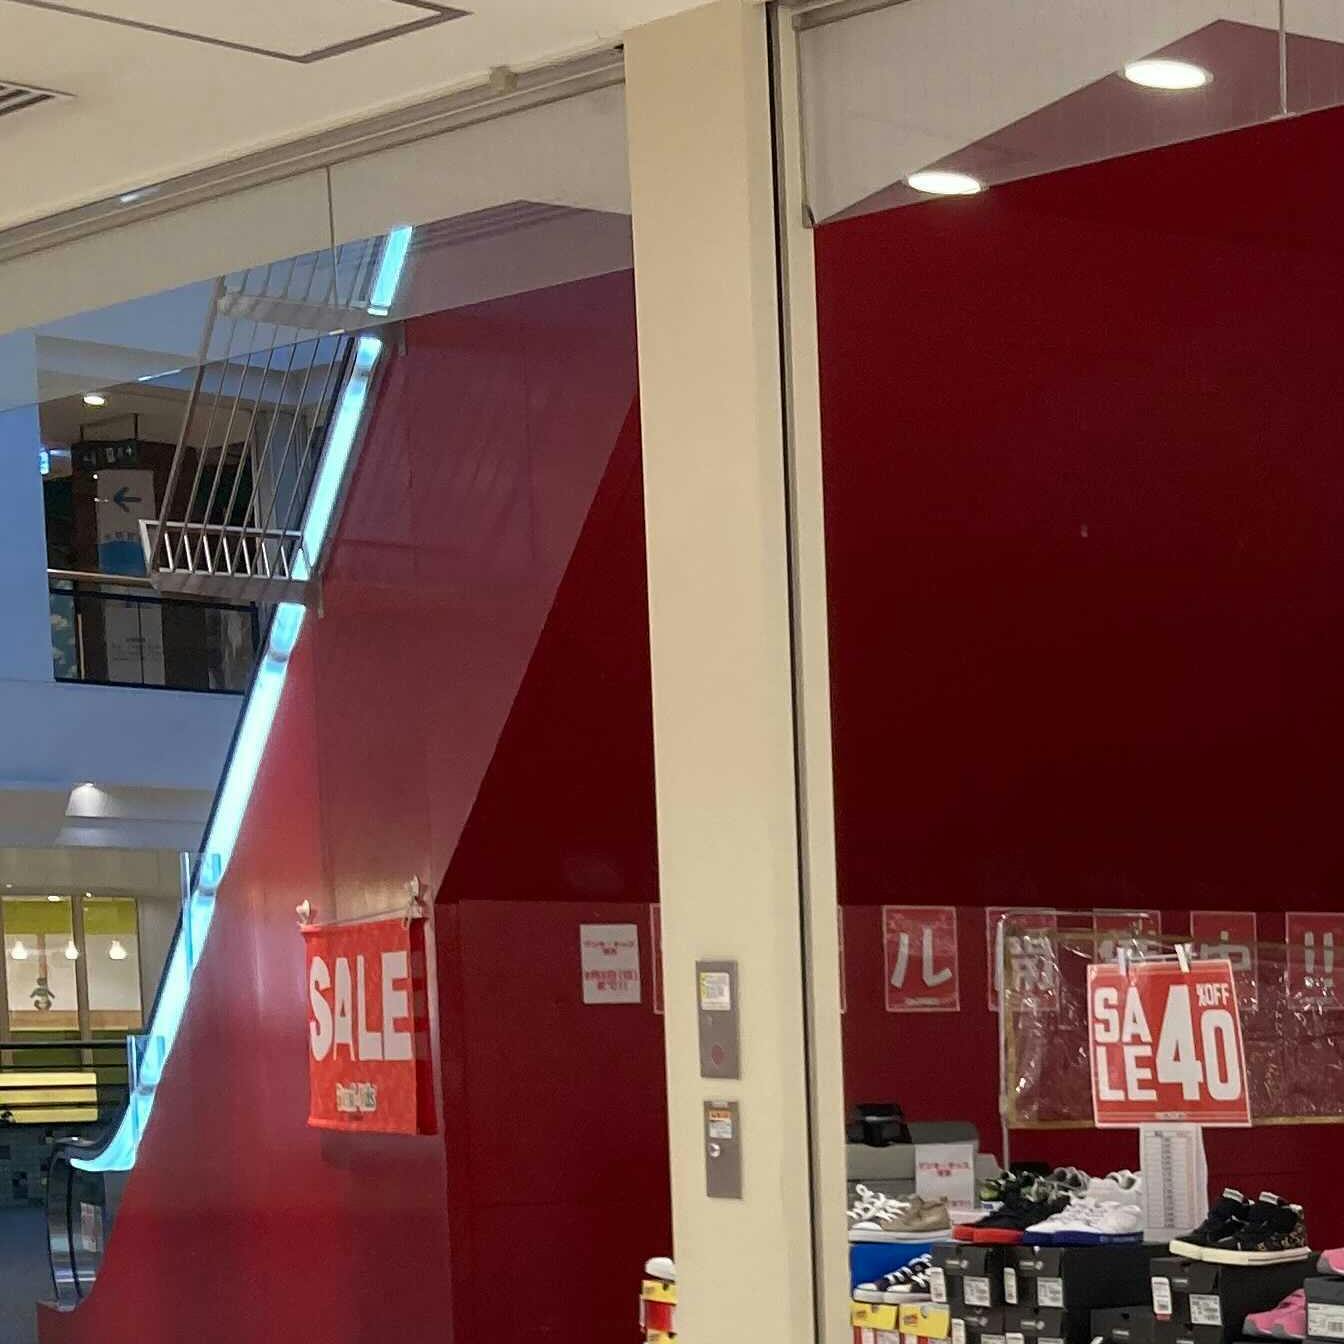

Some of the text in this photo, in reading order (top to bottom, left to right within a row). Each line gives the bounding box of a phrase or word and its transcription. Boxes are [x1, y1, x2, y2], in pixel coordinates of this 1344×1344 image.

[310, 951, 413, 1062] SALE
[1094, 986, 1153, 1043] SA
[1196, 983, 1230, 1007] %OFF
[1155, 984, 1242, 1101] 40
